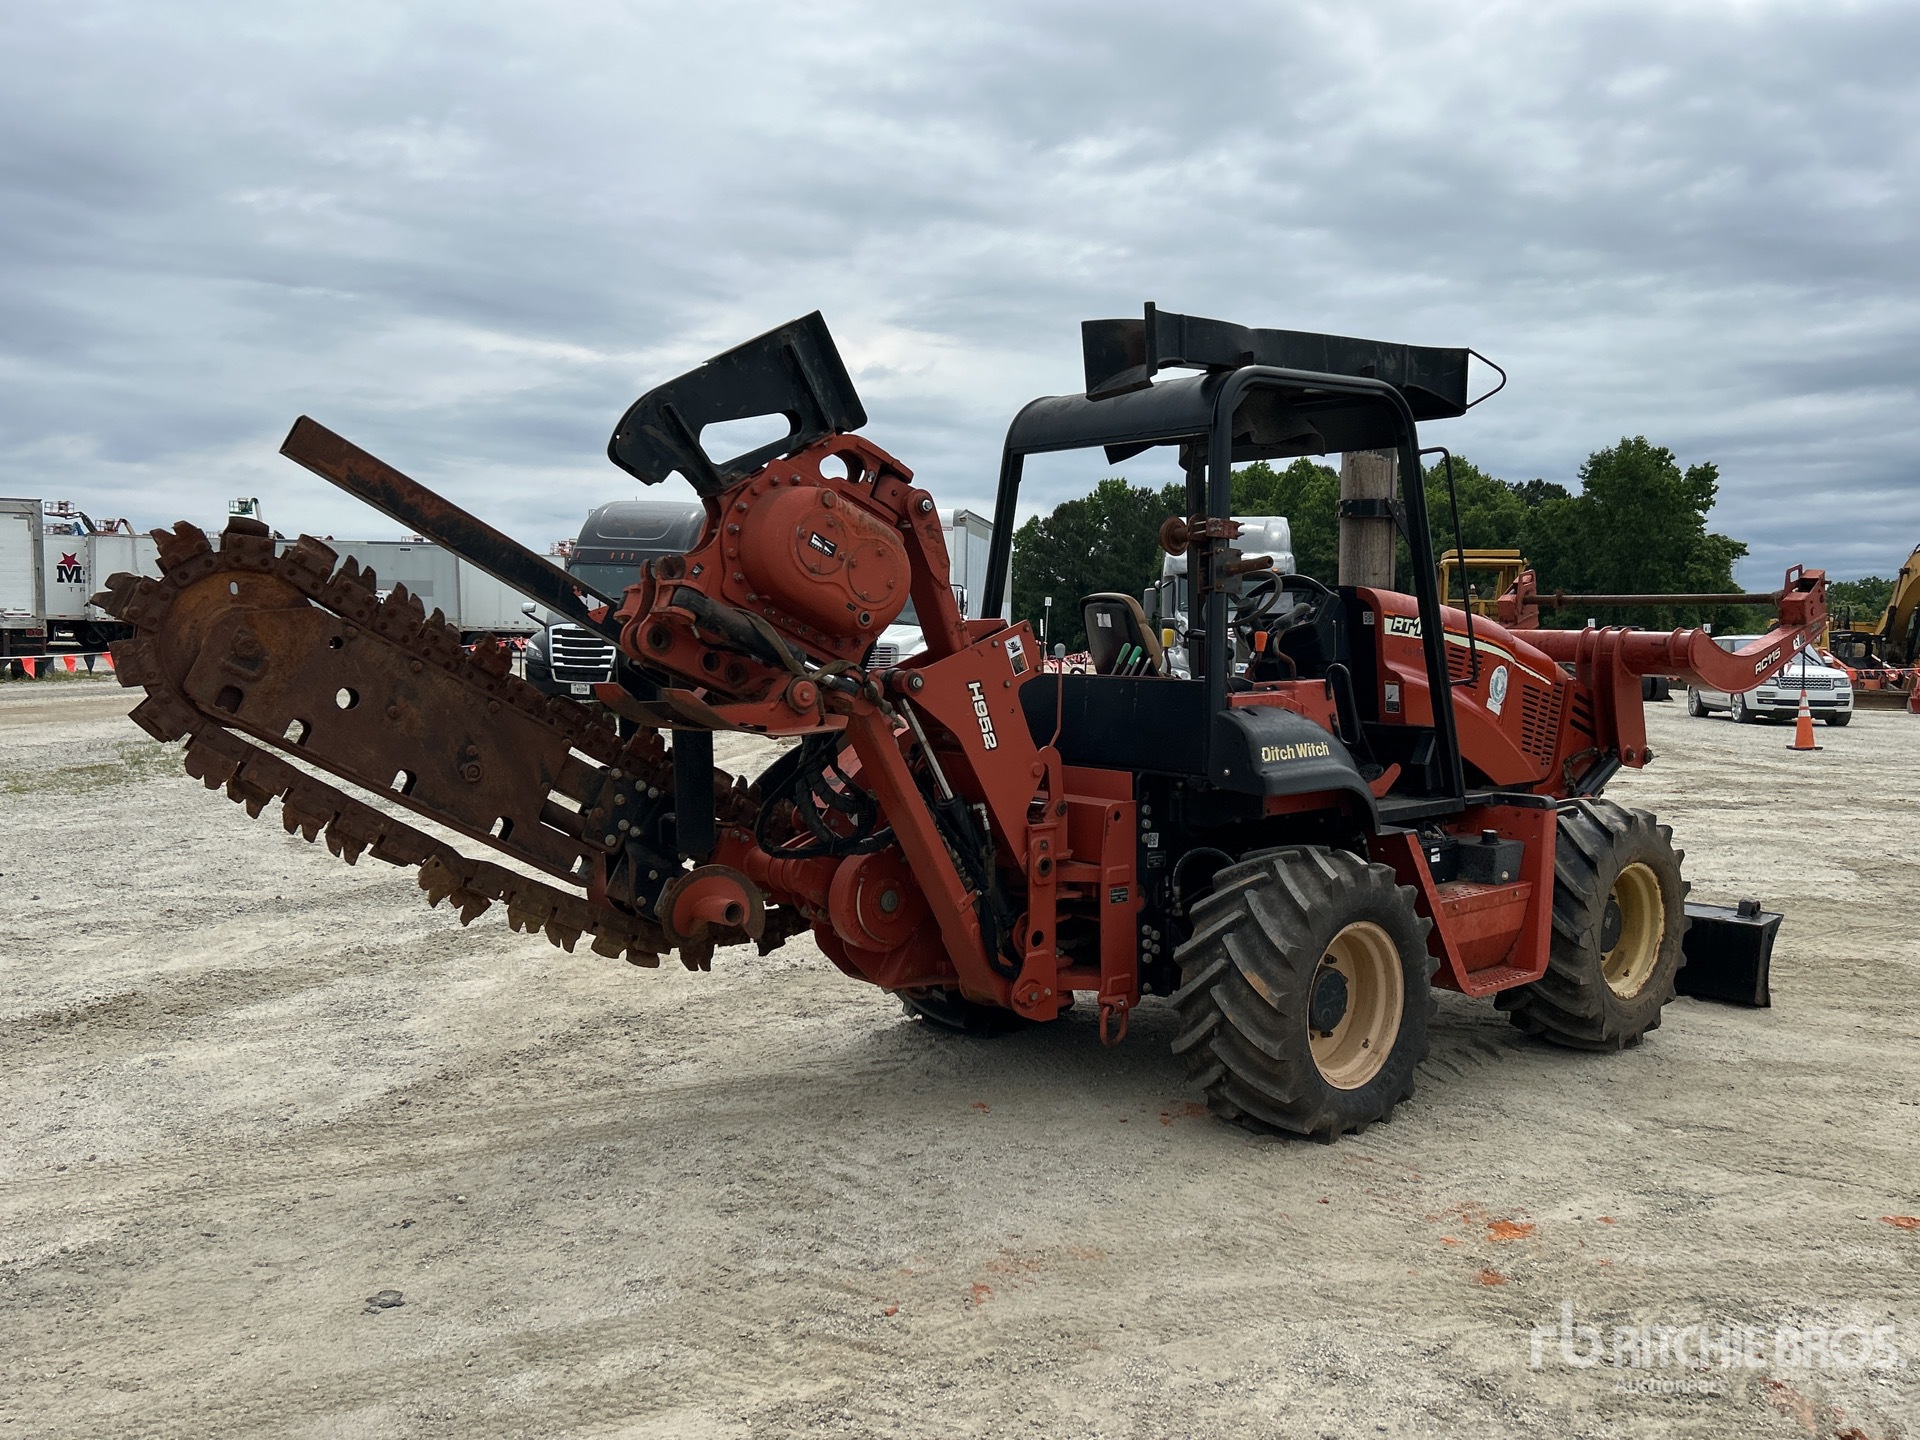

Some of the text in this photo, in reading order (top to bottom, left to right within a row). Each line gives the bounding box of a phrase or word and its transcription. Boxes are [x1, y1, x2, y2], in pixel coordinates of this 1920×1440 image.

[1392, 616, 1421, 635] RT1
[1755, 647, 1781, 675] RC115
[968, 682, 997, 750] H952
[1262, 742, 1330, 762] Ditch Witch
